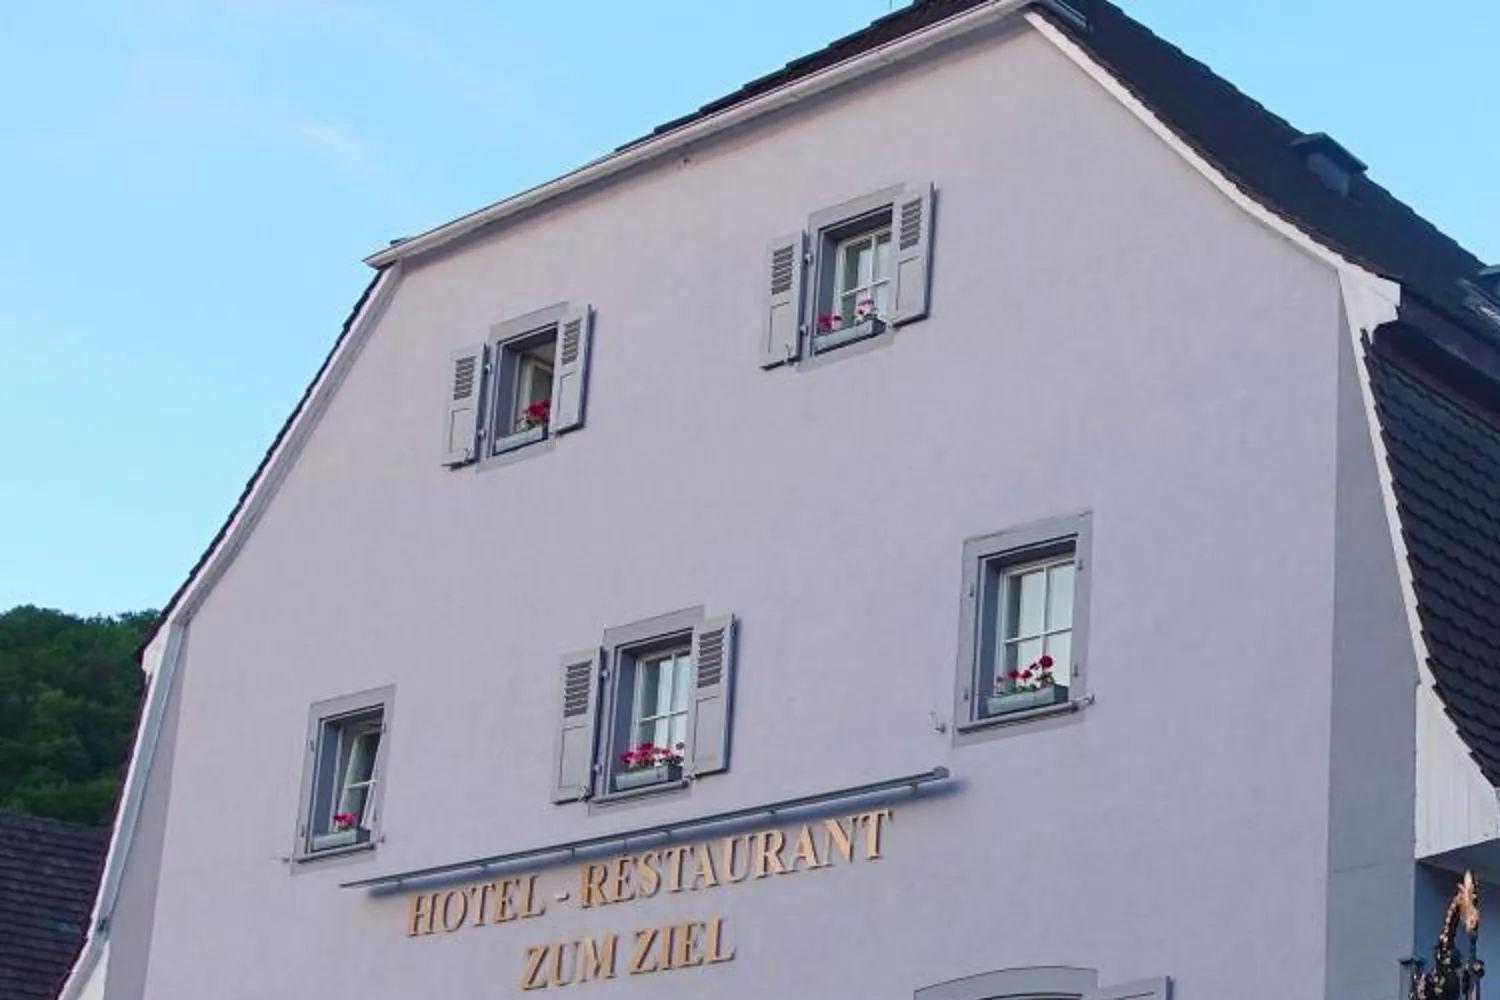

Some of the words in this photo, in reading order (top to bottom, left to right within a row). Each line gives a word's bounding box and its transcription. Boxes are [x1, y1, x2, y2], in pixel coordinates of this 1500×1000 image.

[407, 875, 546, 937] HOTEL
[579, 809, 893, 908] RESTAURANT
[521, 930, 618, 990] ZUM
[629, 912, 736, 975] ZIEL
